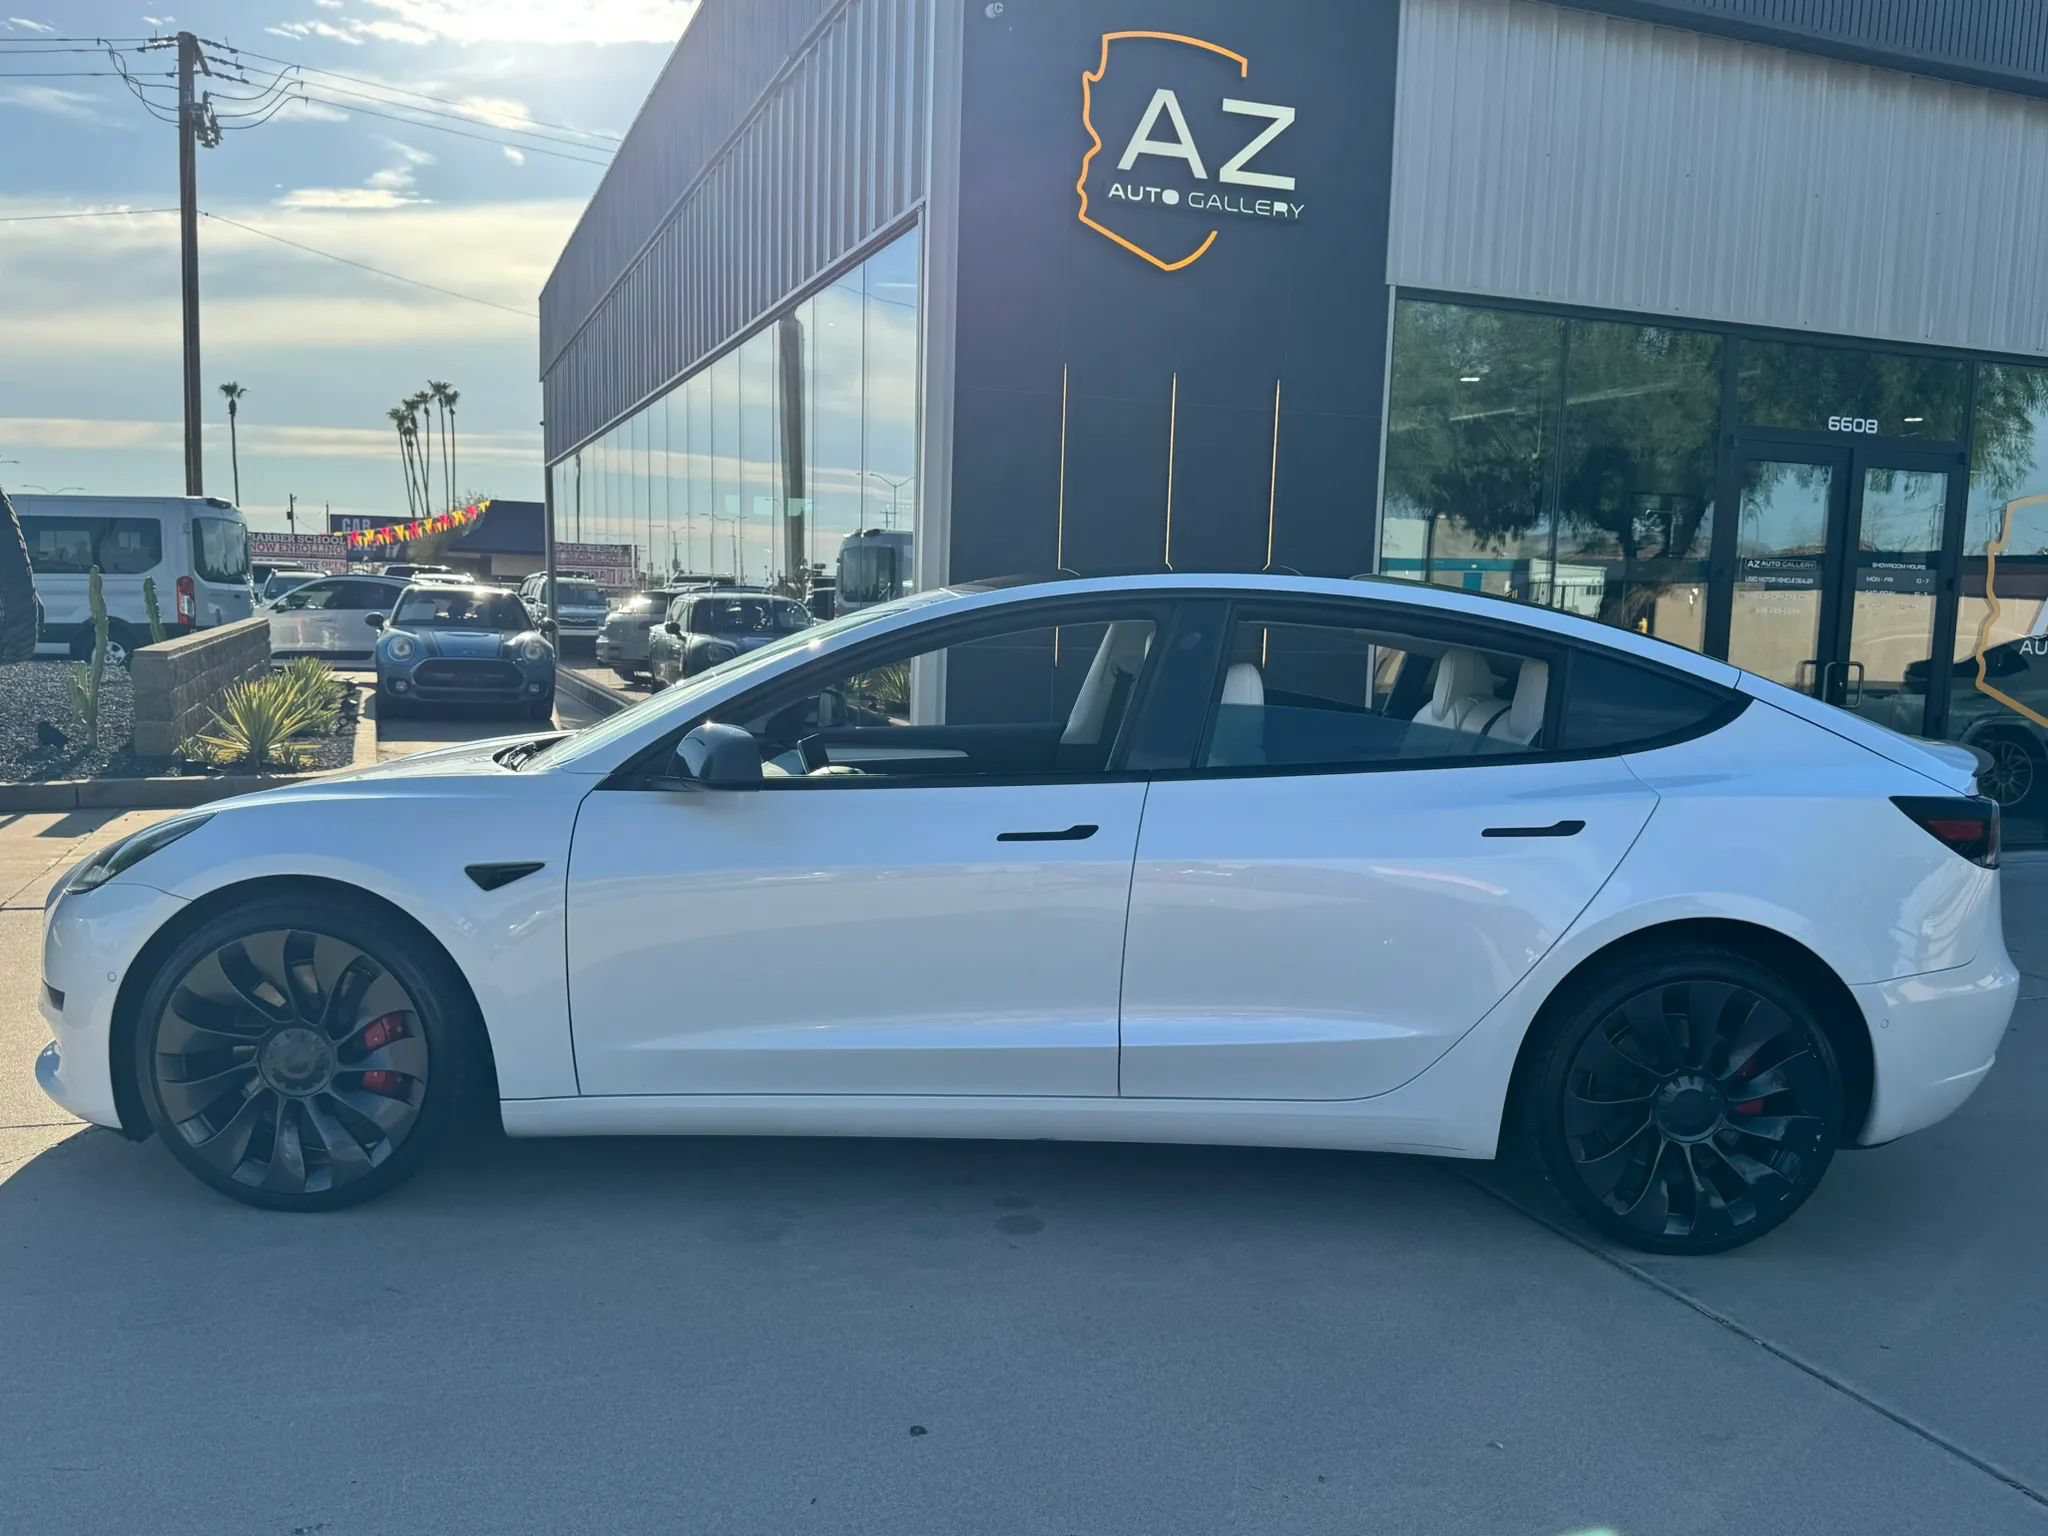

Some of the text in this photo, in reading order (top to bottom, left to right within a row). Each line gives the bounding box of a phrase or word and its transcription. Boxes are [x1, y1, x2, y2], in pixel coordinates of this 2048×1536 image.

[1117, 88, 1296, 191] AZ
[1108, 183, 1305, 219] AUTO GALLERY
[1828, 416, 1878, 434] 6608
[297, 535, 346, 545] SCHOOL
[251, 543, 275, 552] NOW
[321, 560, 346, 569] OPEN
[1747, 560, 1760, 568] AZ
[1782, 561, 1815, 569] GALLERY
